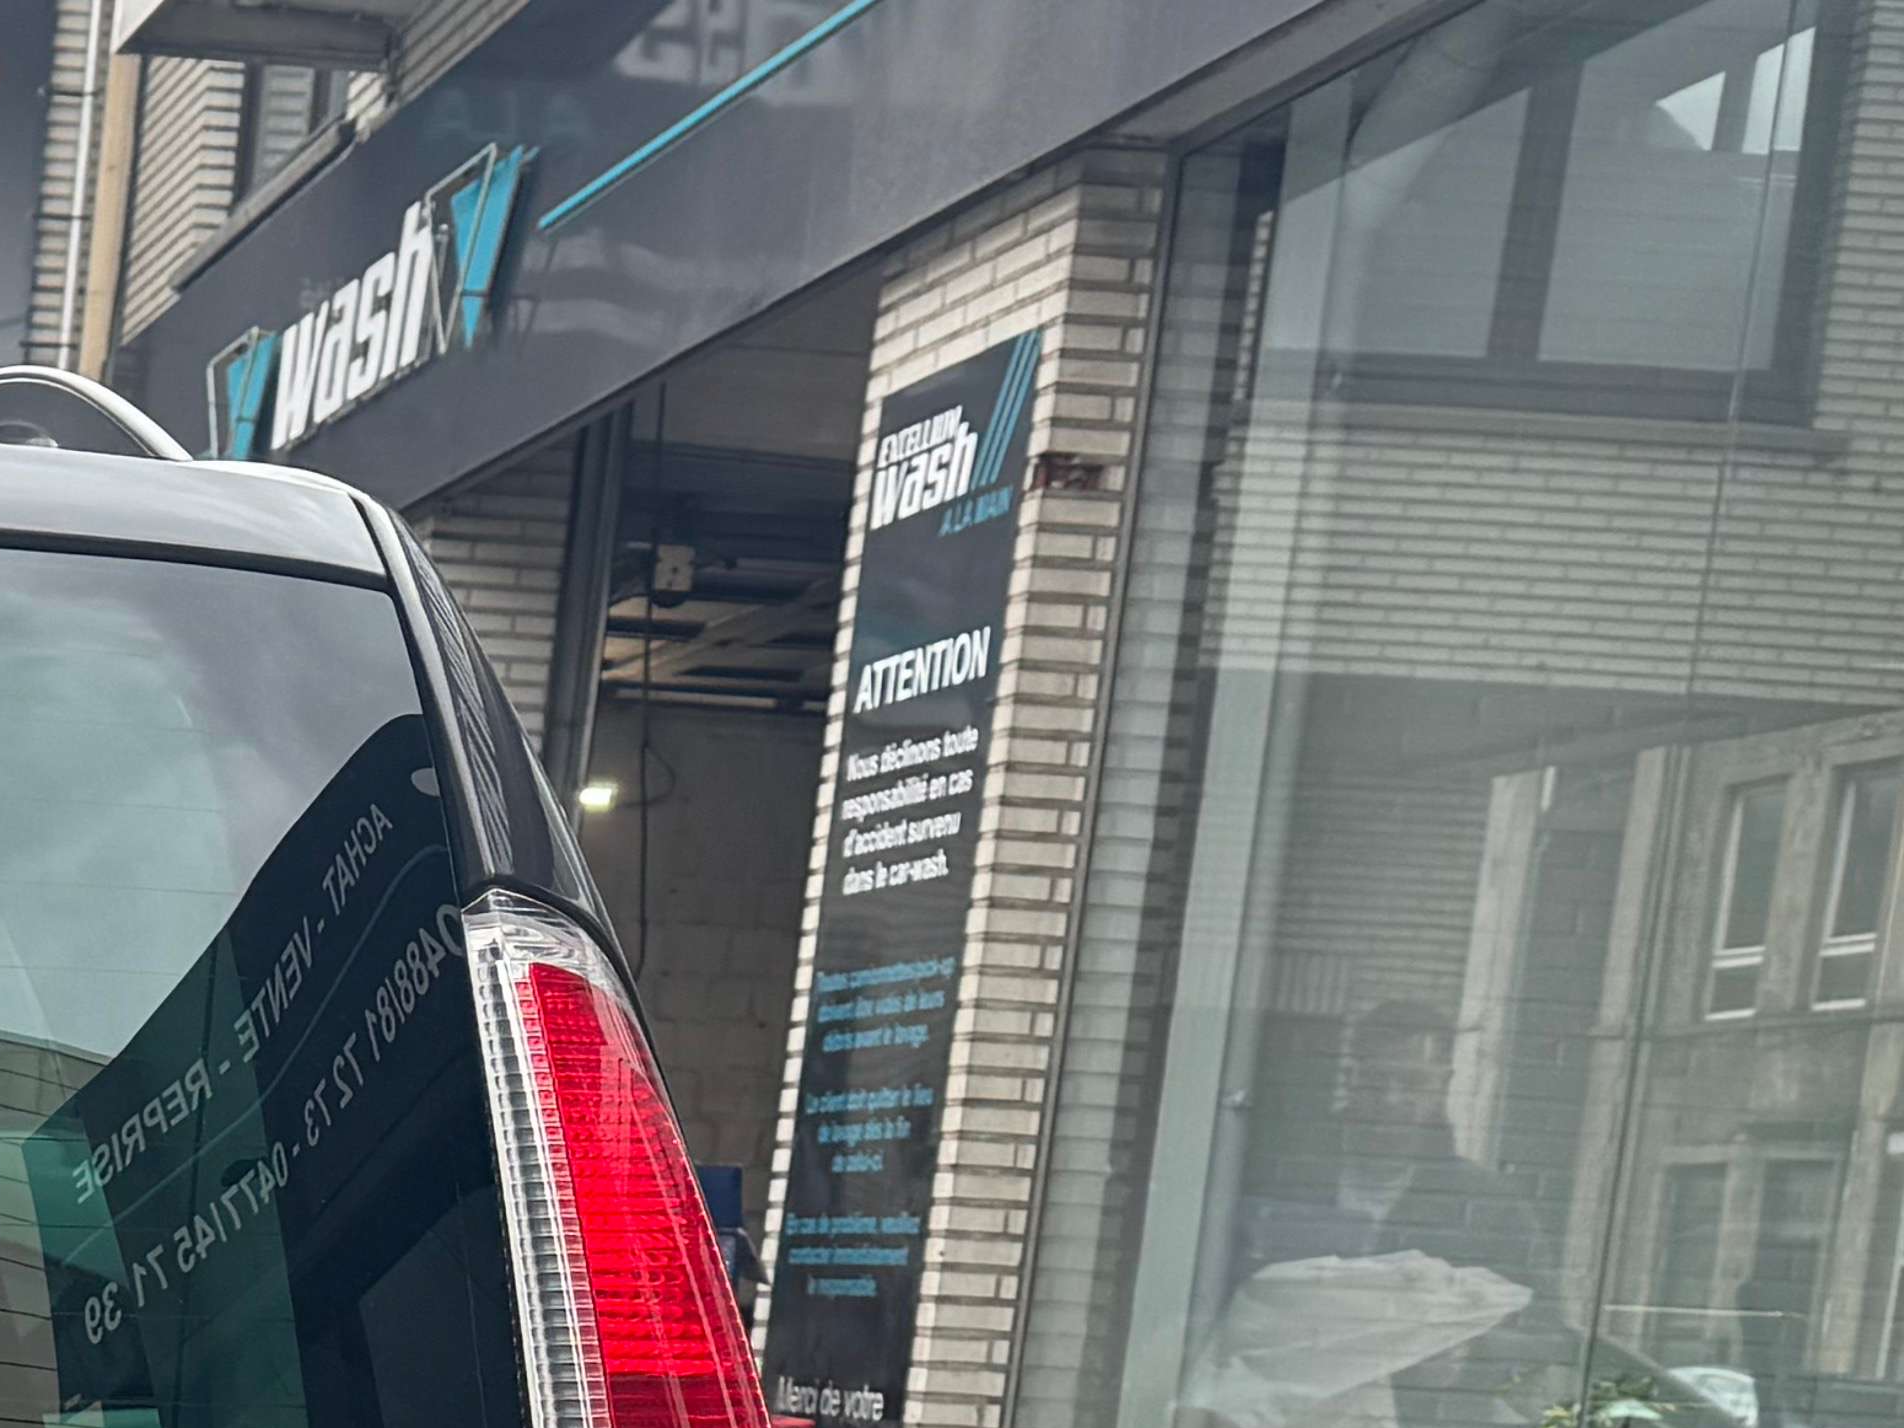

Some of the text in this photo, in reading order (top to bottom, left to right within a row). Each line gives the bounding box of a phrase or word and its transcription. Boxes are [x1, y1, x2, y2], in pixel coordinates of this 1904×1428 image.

[270, 199, 432, 451] wash
[870, 421, 978, 530] wash
[852, 625, 992, 714] ATTENTION
[775, 1376, 884, 1421] Merci de votre
